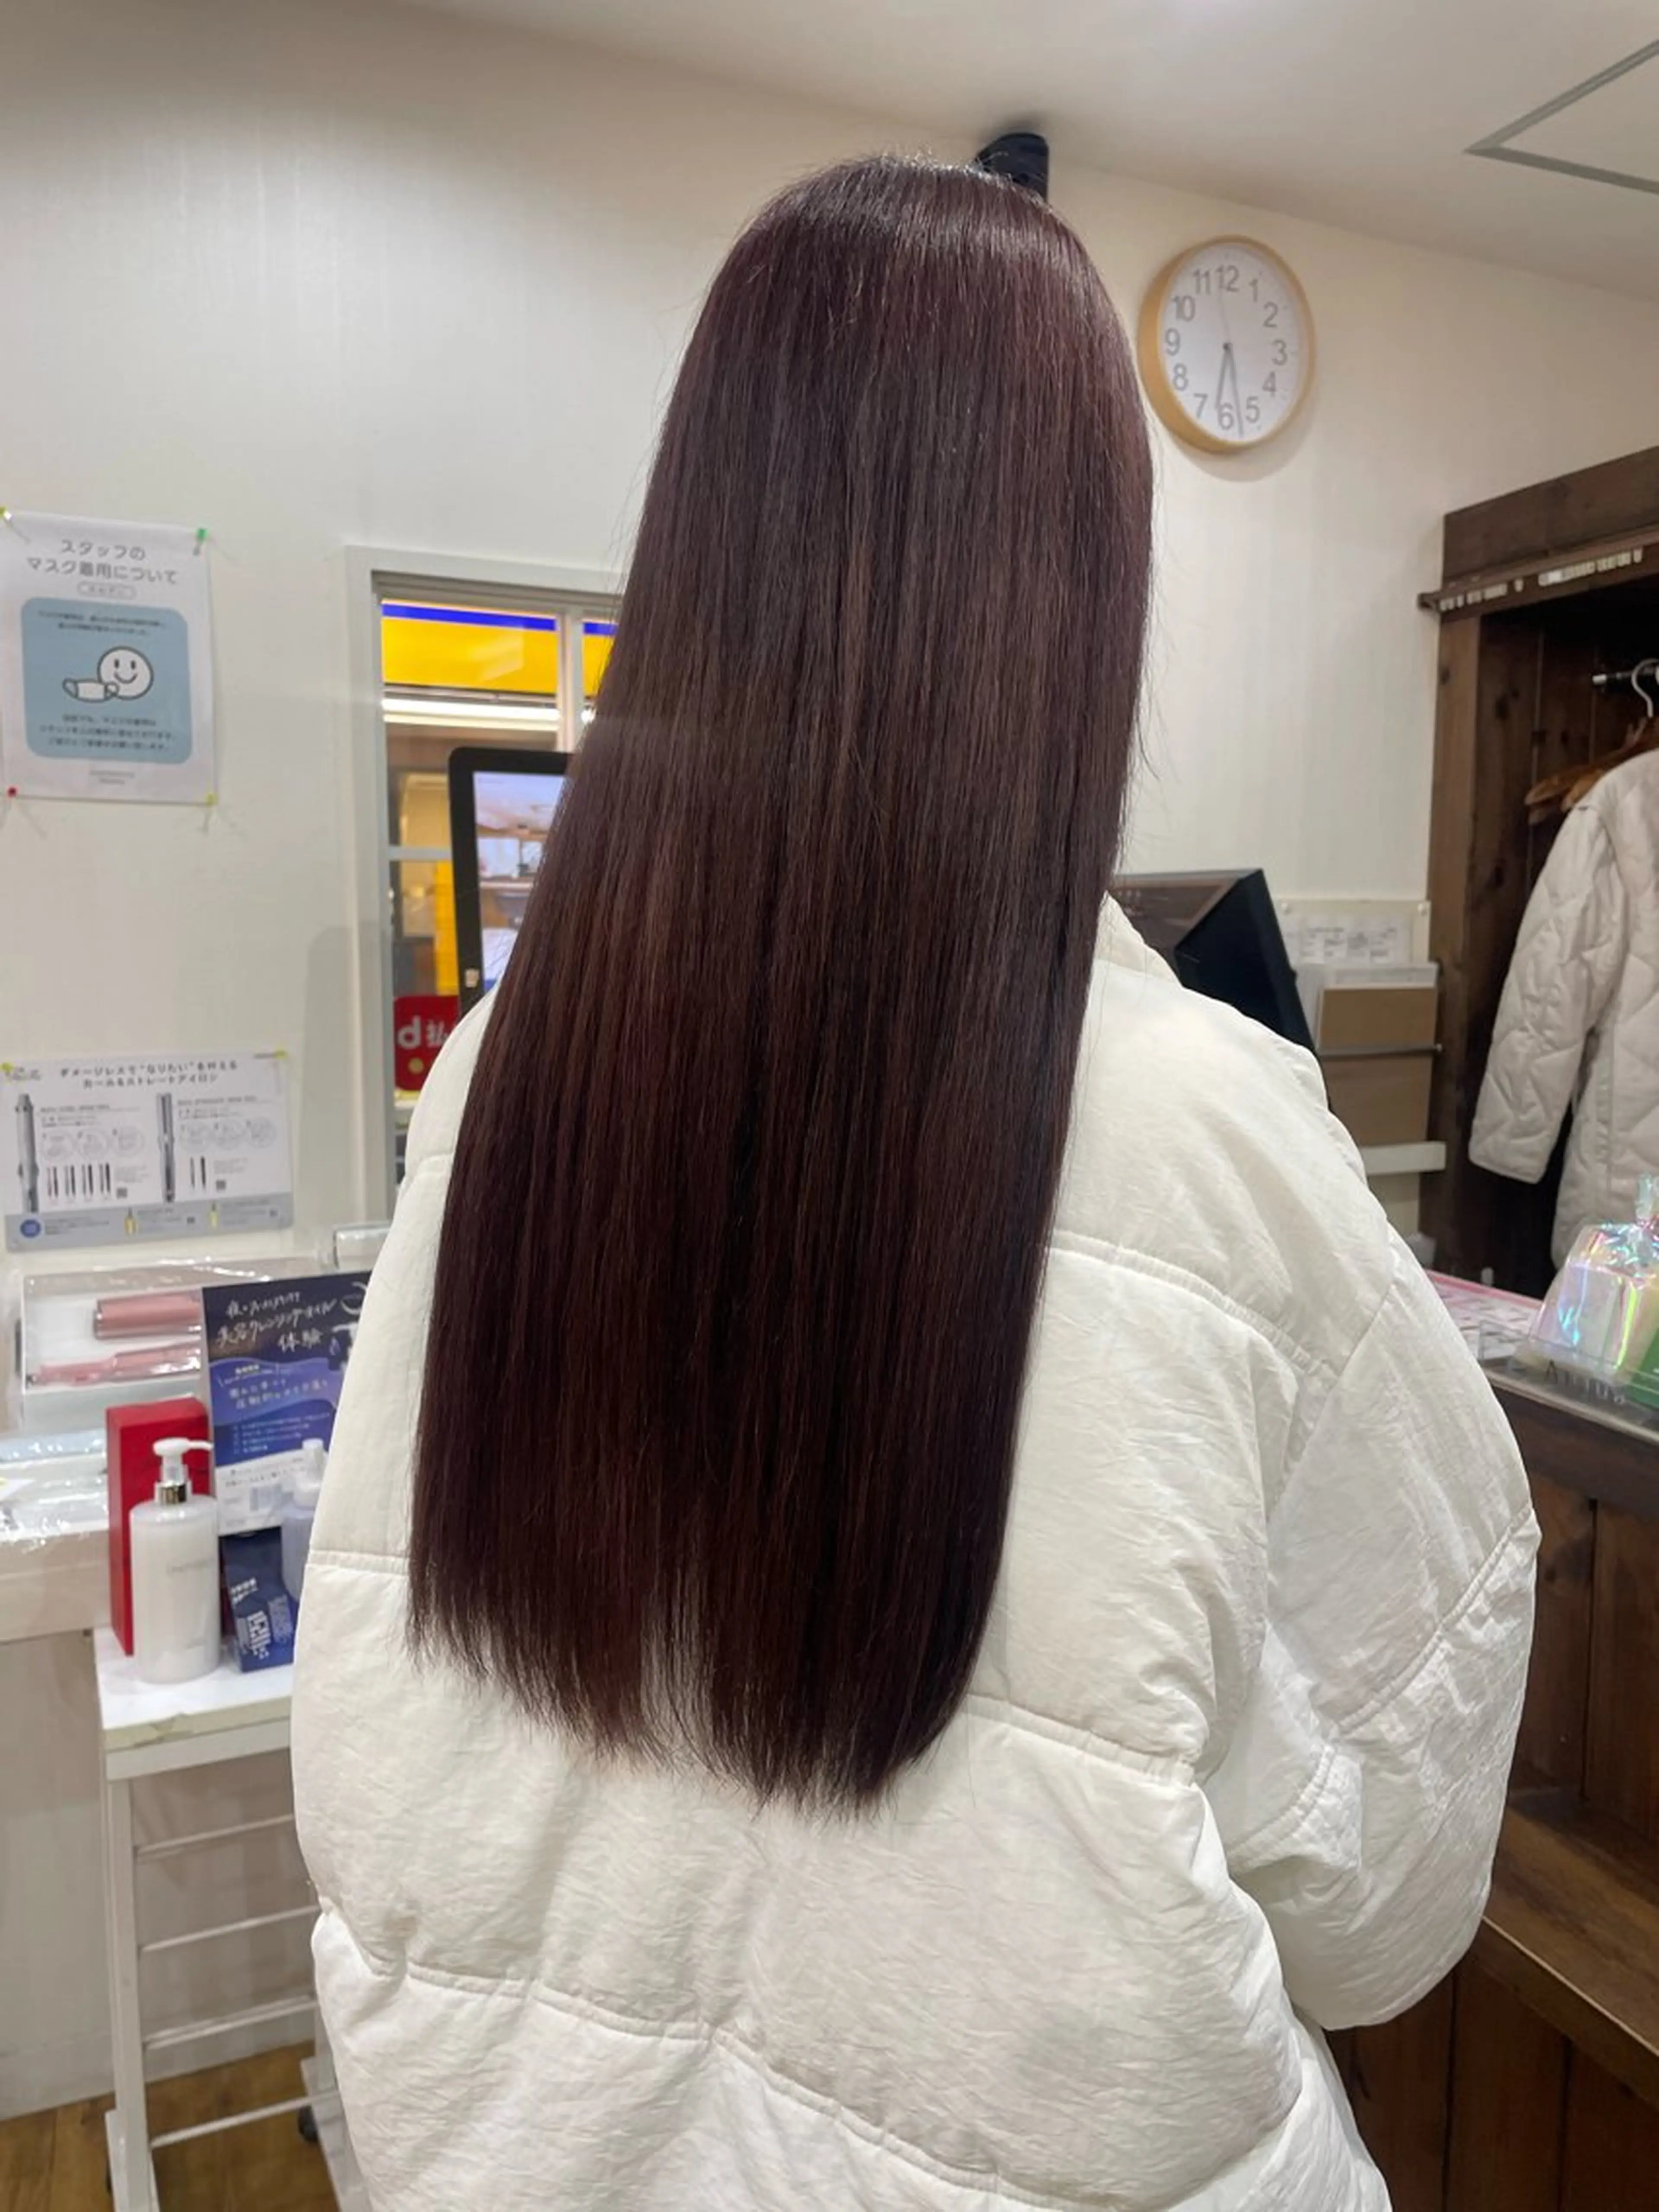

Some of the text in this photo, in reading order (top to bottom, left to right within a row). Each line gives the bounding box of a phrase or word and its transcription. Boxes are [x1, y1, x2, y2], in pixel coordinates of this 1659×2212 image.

[1194, 268, 1211, 295] 11
[1216, 265, 1239, 292] 12
[1249, 279, 1258, 301] 1
[1172, 295, 1196, 321] 10
[1263, 302, 1278, 328] 2
[1165, 327, 1180, 356] 9
[1271, 339, 1288, 365] 3
[1173, 363, 1189, 391] 8
[1262, 371, 1277, 397] 4
[1193, 393, 1208, 419] 7
[1218, 403, 1234, 430] 6
[1245, 396, 1260, 423] 5
[61, 539, 146, 561] スタッフの
[26, 557, 178, 585] マスク着用について
